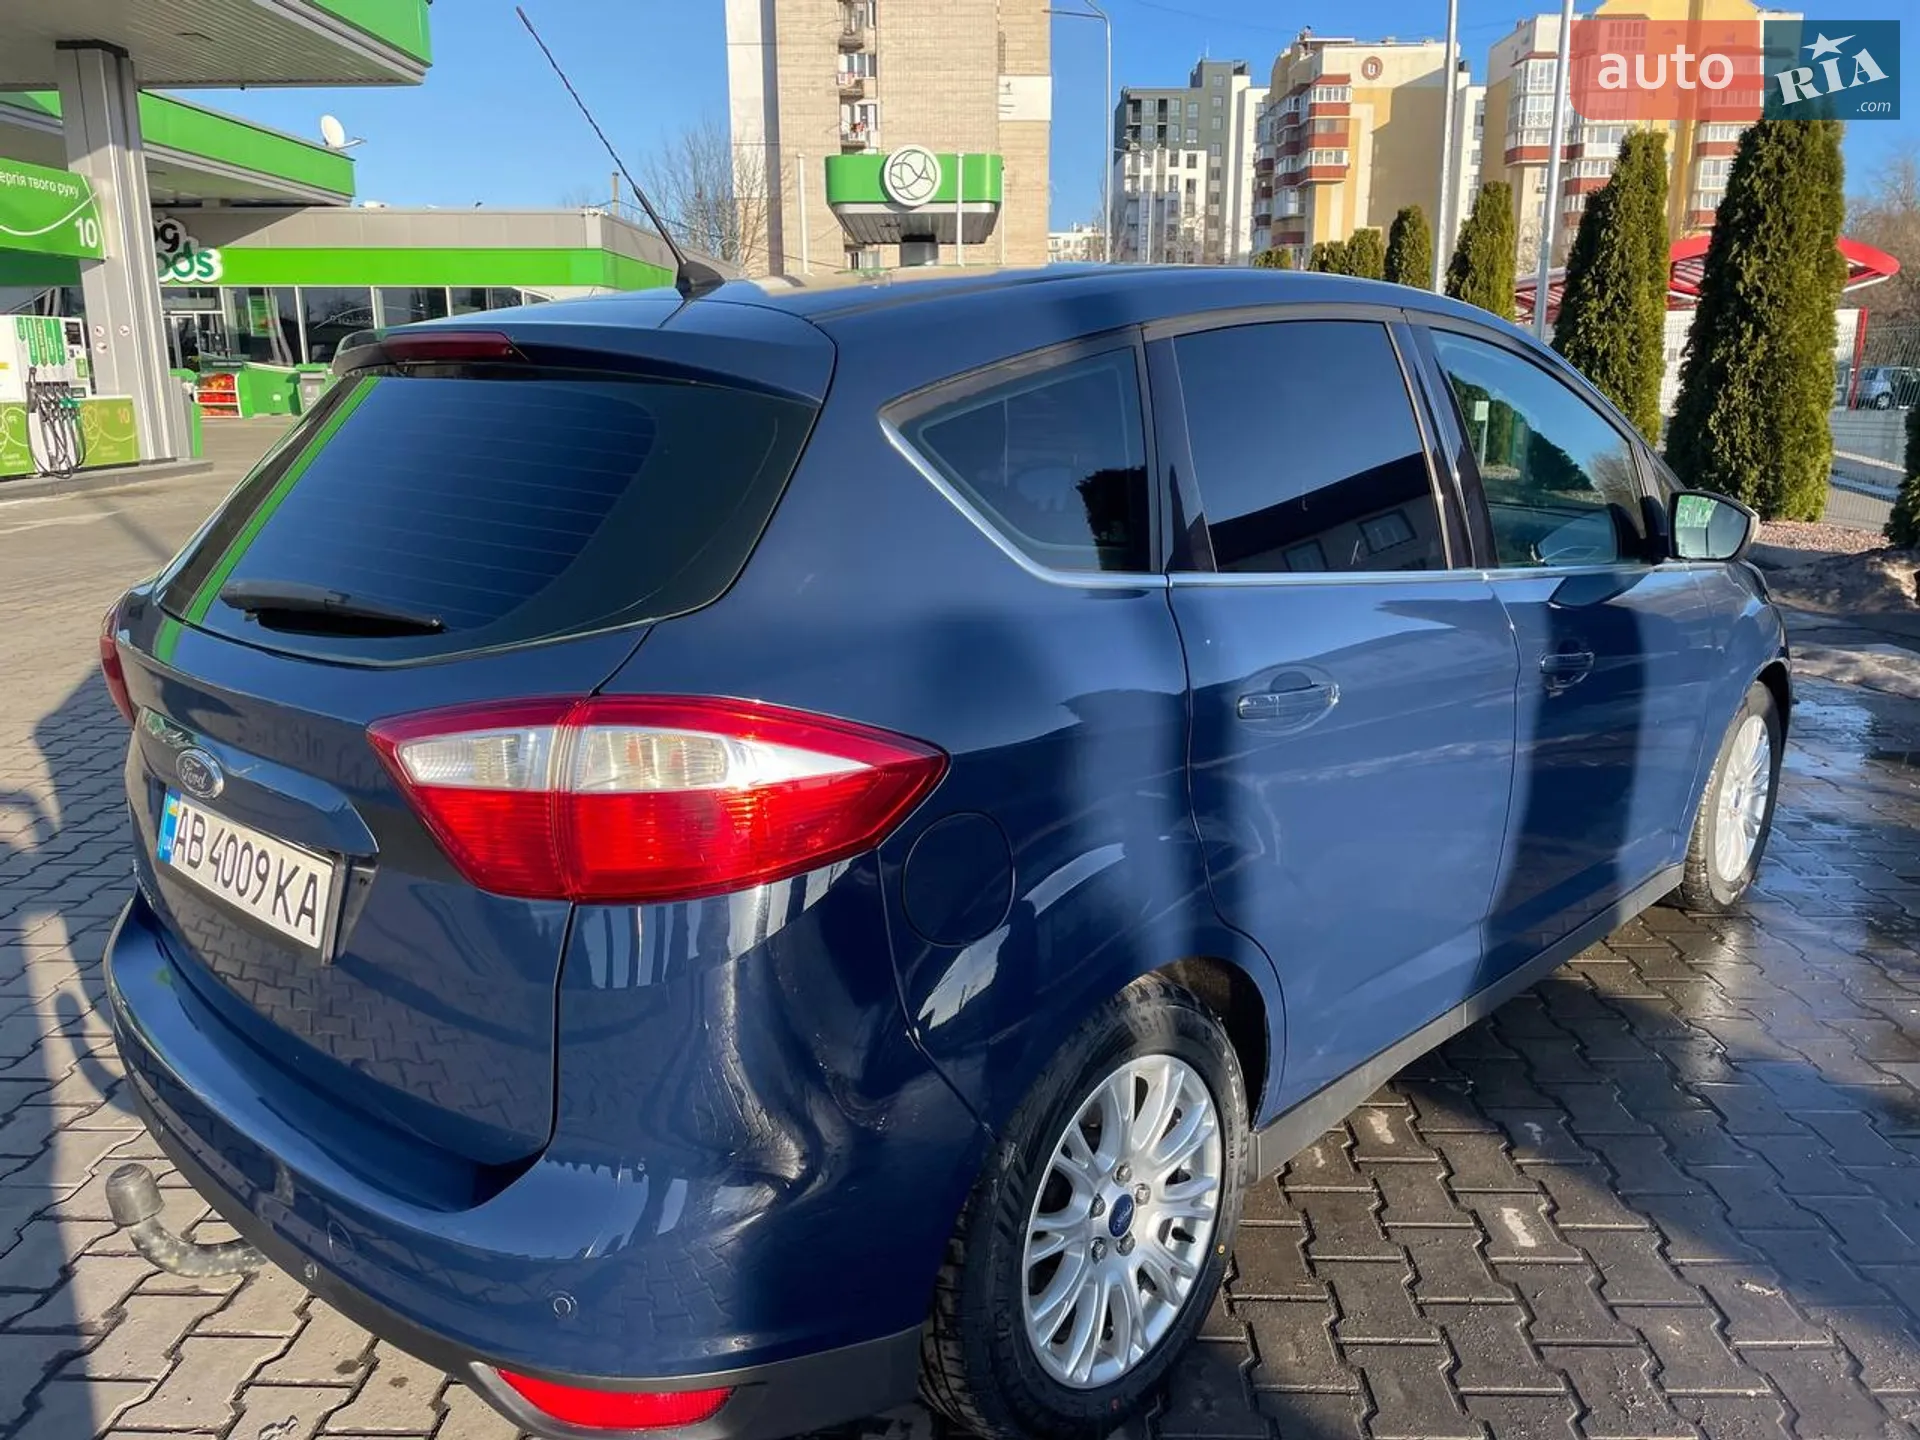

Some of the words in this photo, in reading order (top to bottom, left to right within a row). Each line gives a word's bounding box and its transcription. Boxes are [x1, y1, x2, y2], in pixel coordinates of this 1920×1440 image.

[27, 176, 57, 192] твого
[57, 182, 80, 200] руху
[75, 217, 98, 248] 10
[173, 806, 206, 870] AB
[208, 827, 271, 906] 4009
[271, 857, 320, 937] KA
